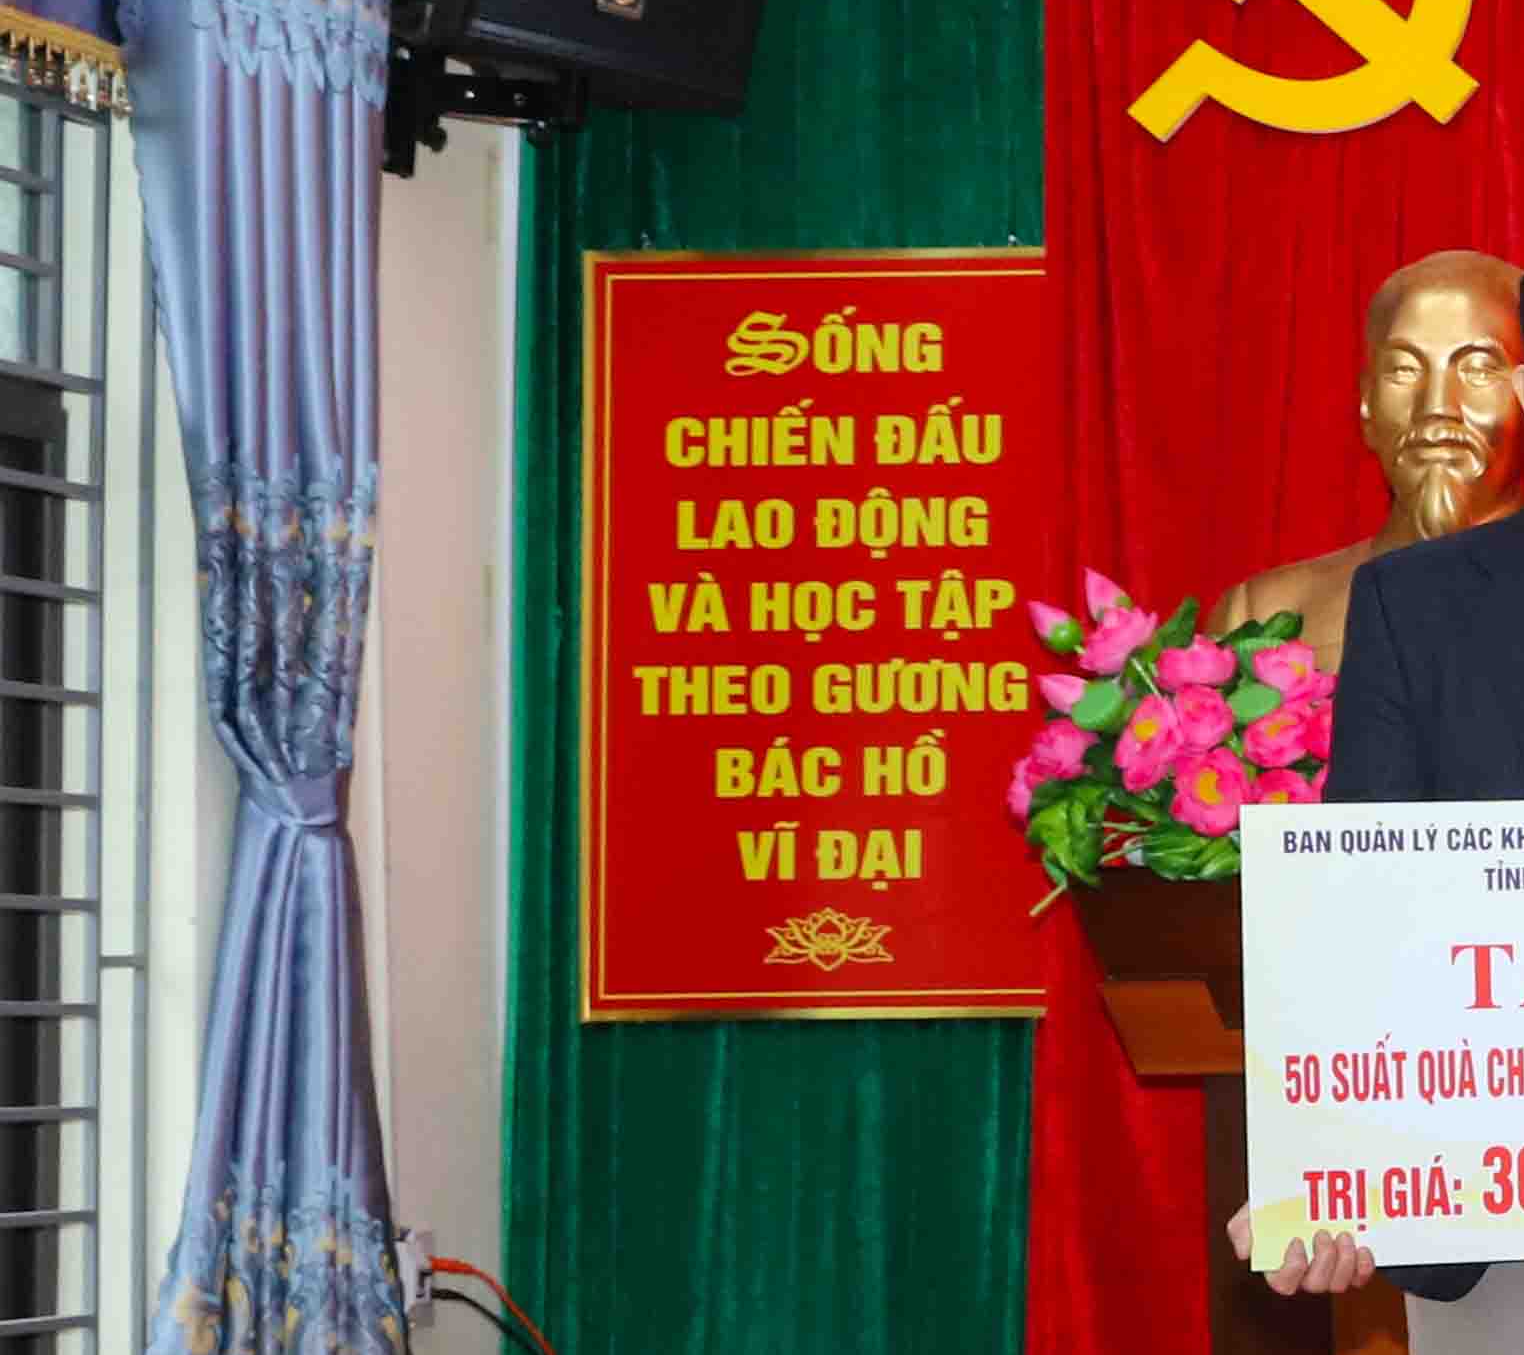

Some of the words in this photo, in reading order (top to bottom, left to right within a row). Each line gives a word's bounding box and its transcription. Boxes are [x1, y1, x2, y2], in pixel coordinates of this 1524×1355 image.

[725, 306, 942, 375] SỐNG
[666, 399, 854, 467] CHIẾN
[874, 397, 1001, 464] ĐẤU
[678, 499, 794, 549] LAO
[815, 487, 988, 558] ĐỘNG
[649, 573, 729, 632] VÀ
[751, 581, 875, 641] HỌC
[896, 569, 1015, 640] TẬP
[634, 665, 790, 715] THEO
[814, 658, 1028, 713] GƯƠNG
[716, 737, 841, 797] BÁC
[864, 729, 945, 795] HỒ
[738, 821, 799, 880] VĨ
[816, 829, 921, 890] ĐẠI
[1285, 1054, 1320, 1103] 50
[1332, 1034, 1406, 1102] SUẤT
[1418, 1039, 1477, 1104] QUÀ
[1304, 1169, 1367, 1231] TRỊ
[1383, 1154, 1463, 1219] GIÁ:
